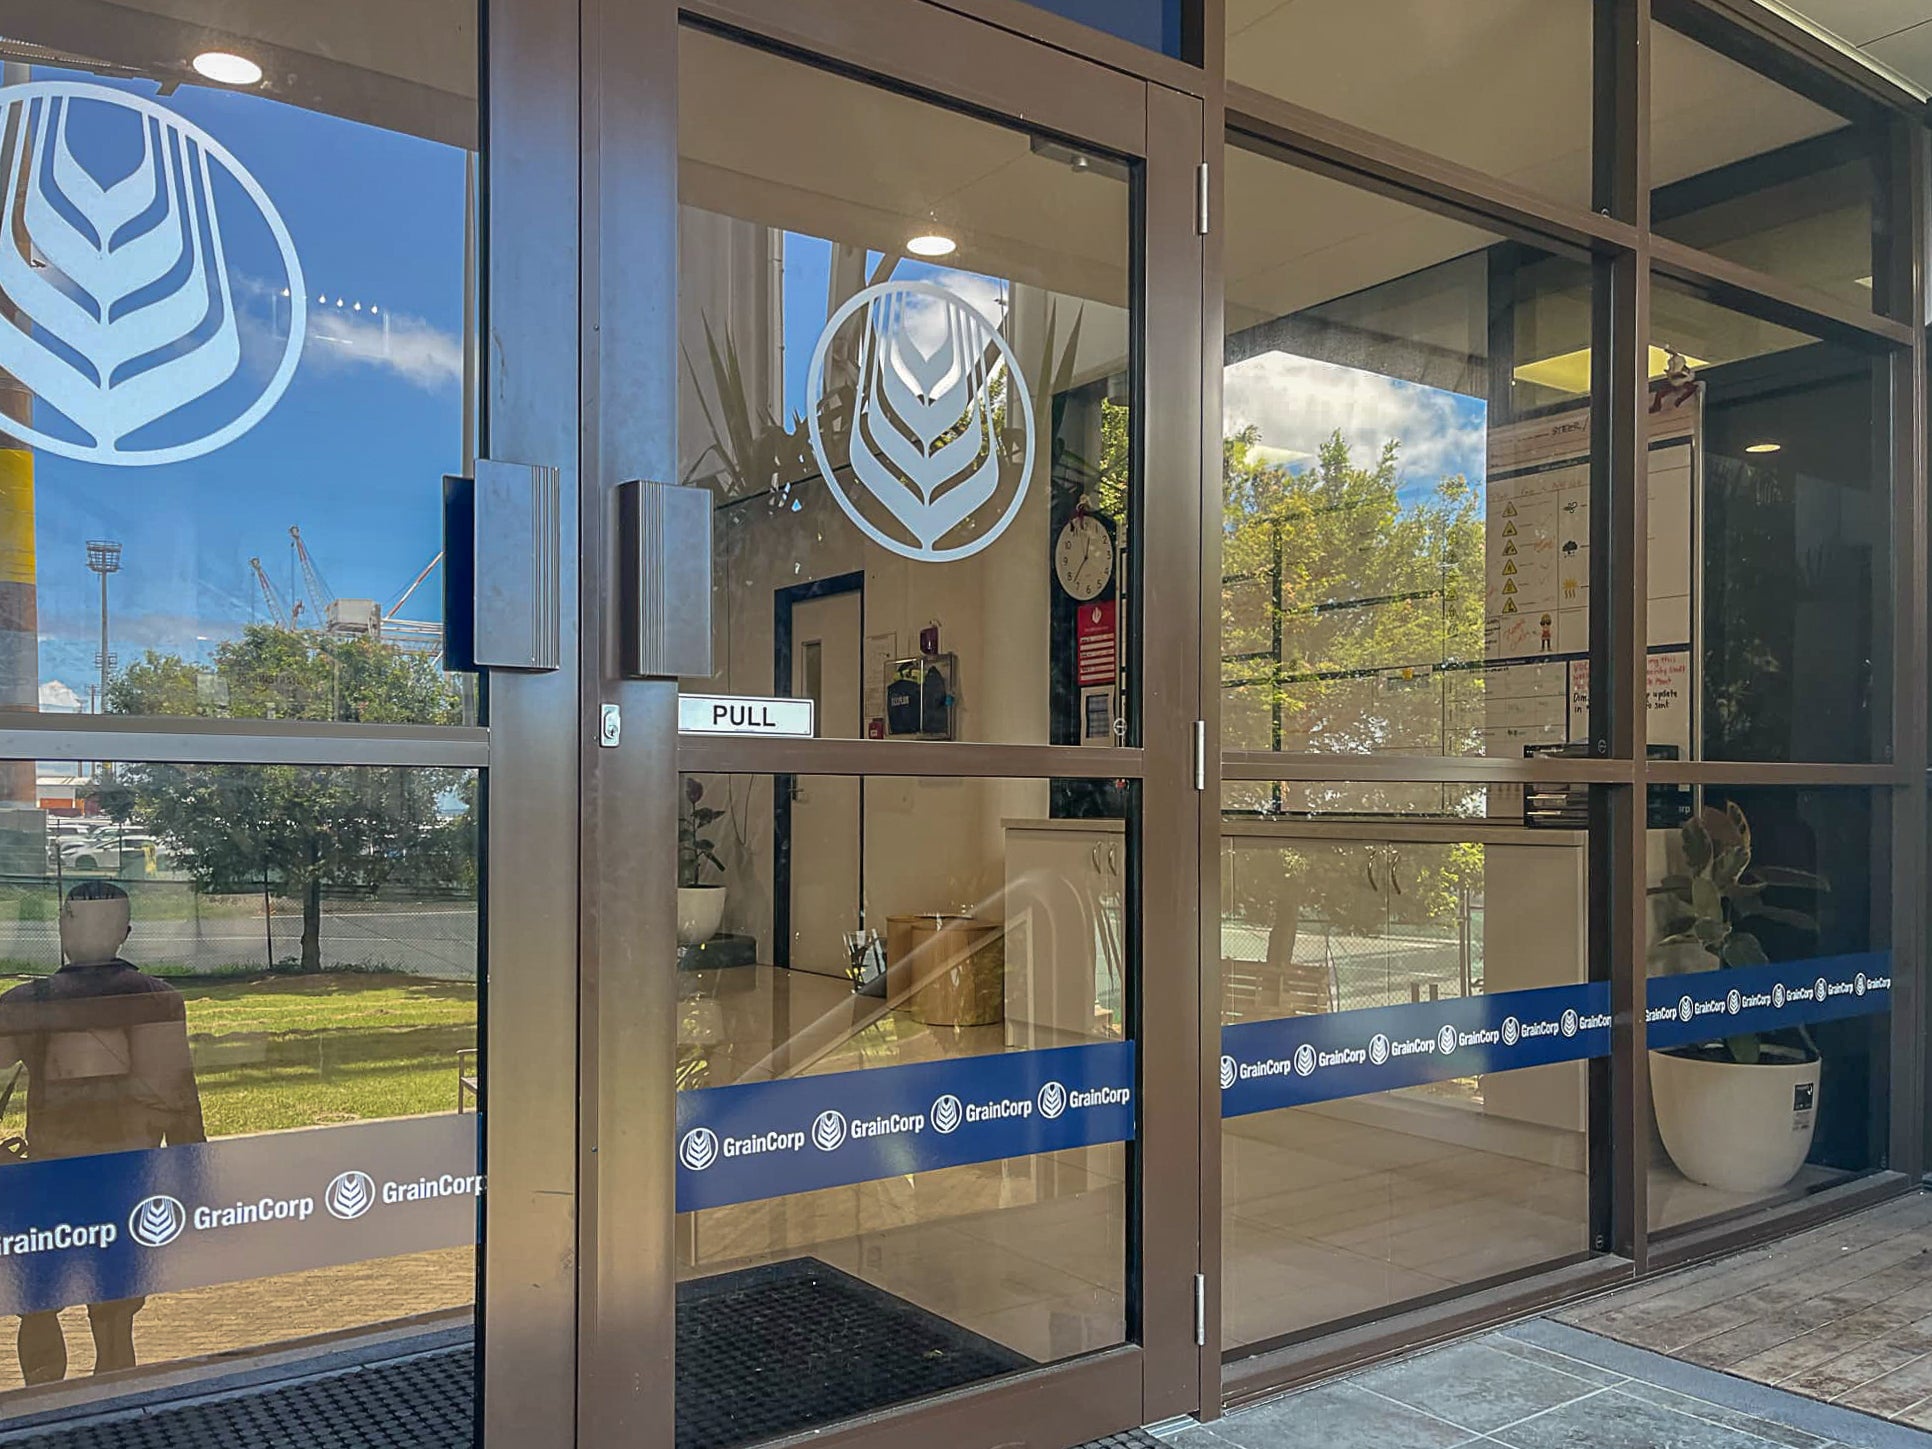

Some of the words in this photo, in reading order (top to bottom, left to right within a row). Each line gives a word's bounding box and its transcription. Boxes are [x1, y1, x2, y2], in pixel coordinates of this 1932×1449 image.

[1065, 540, 1072, 550] 10
[1102, 535, 1108, 545] 2
[1107, 550, 1111, 560] 3
[1086, 584, 1091, 594] 6
[1097, 580, 1102, 589] 5
[1653, 689, 1678, 700] update
[713, 704, 776, 727] PULL
[1694, 1000, 1725, 1014] GrainCorp
[1742, 994, 1771, 1008] GrainCorp
[1786, 987, 1814, 1001] GrainCorp
[1827, 982, 1854, 996] GrainCorp
[1239, 1059, 1291, 1080] GrainCorp
[1318, 1049, 1366, 1067] GrainCorp
[1392, 1038, 1435, 1056] GrainCorp
[1458, 1028, 1500, 1046] GrainCorp
[1521, 1021, 1560, 1037] GrainCorp
[723, 1131, 805, 1157] GrainCorp
[851, 1113, 925, 1139] GrainCorp
[965, 1100, 1032, 1123] GrainCorp
[1069, 1087, 1130, 1109] GrainCorp
[0, 1223, 117, 1256] rainCorp
[194, 1194, 314, 1231] GrainCorp
